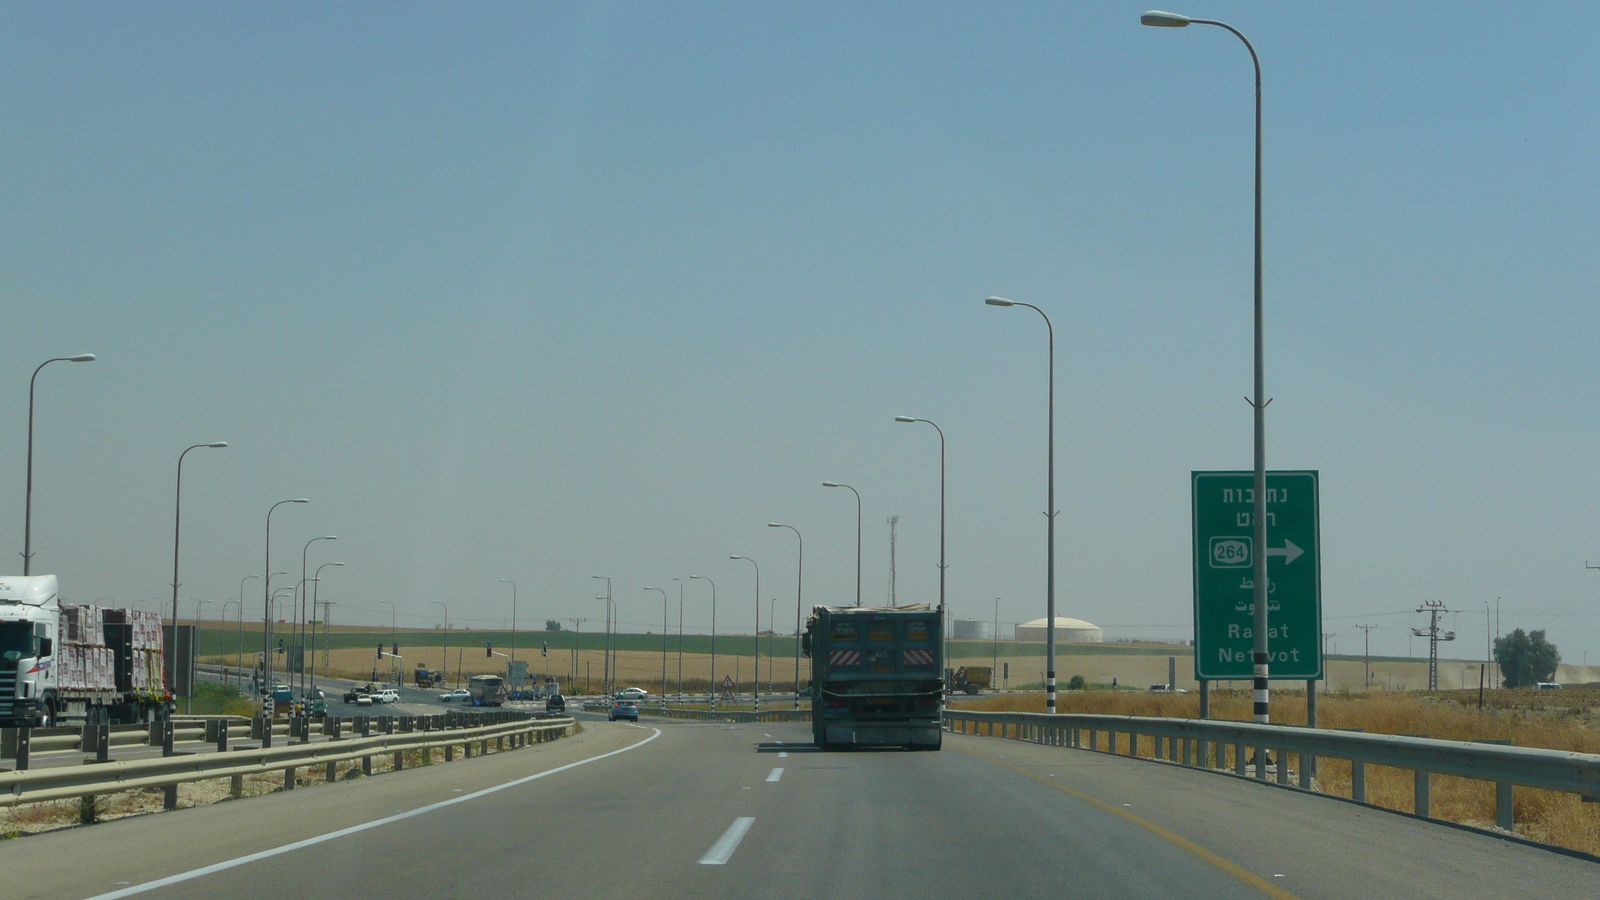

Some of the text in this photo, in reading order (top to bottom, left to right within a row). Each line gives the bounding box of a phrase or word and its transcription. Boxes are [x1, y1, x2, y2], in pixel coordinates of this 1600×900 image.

[1223, 488, 1288, 503] נתבות
[1236, 512, 1276, 527] רט
[1217, 545, 1245, 559] 264
[1228, 623, 1289, 638] Raat
[1218, 647, 1299, 662] Netvot
